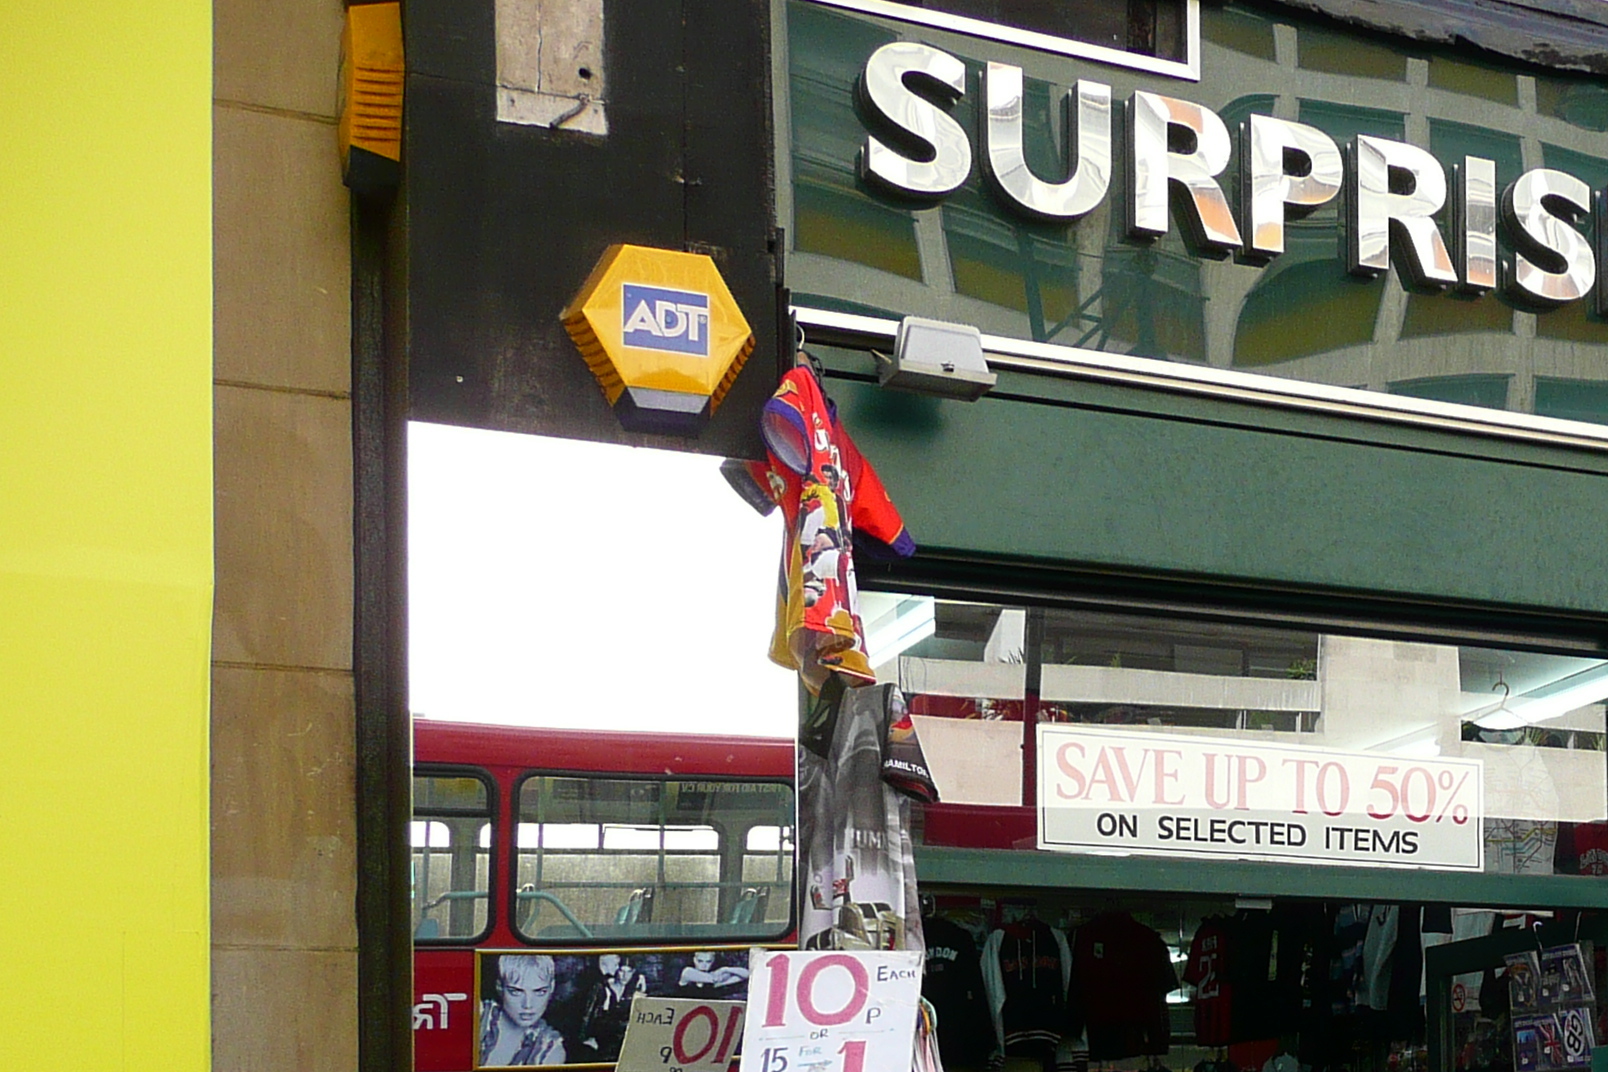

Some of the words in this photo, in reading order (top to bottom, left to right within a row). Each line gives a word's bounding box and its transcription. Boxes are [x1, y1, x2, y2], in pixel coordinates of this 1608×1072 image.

[623, 300, 704, 341] ADT
[1056, 741, 1186, 804] SAVE
[1202, 752, 1267, 810] UP
[1283, 758, 1350, 816] TO
[1366, 765, 1469, 825] 50%
[1096, 812, 1138, 838] ON
[1158, 816, 1307, 847] SELECTED
[1325, 826, 1419, 855] ITEMS
